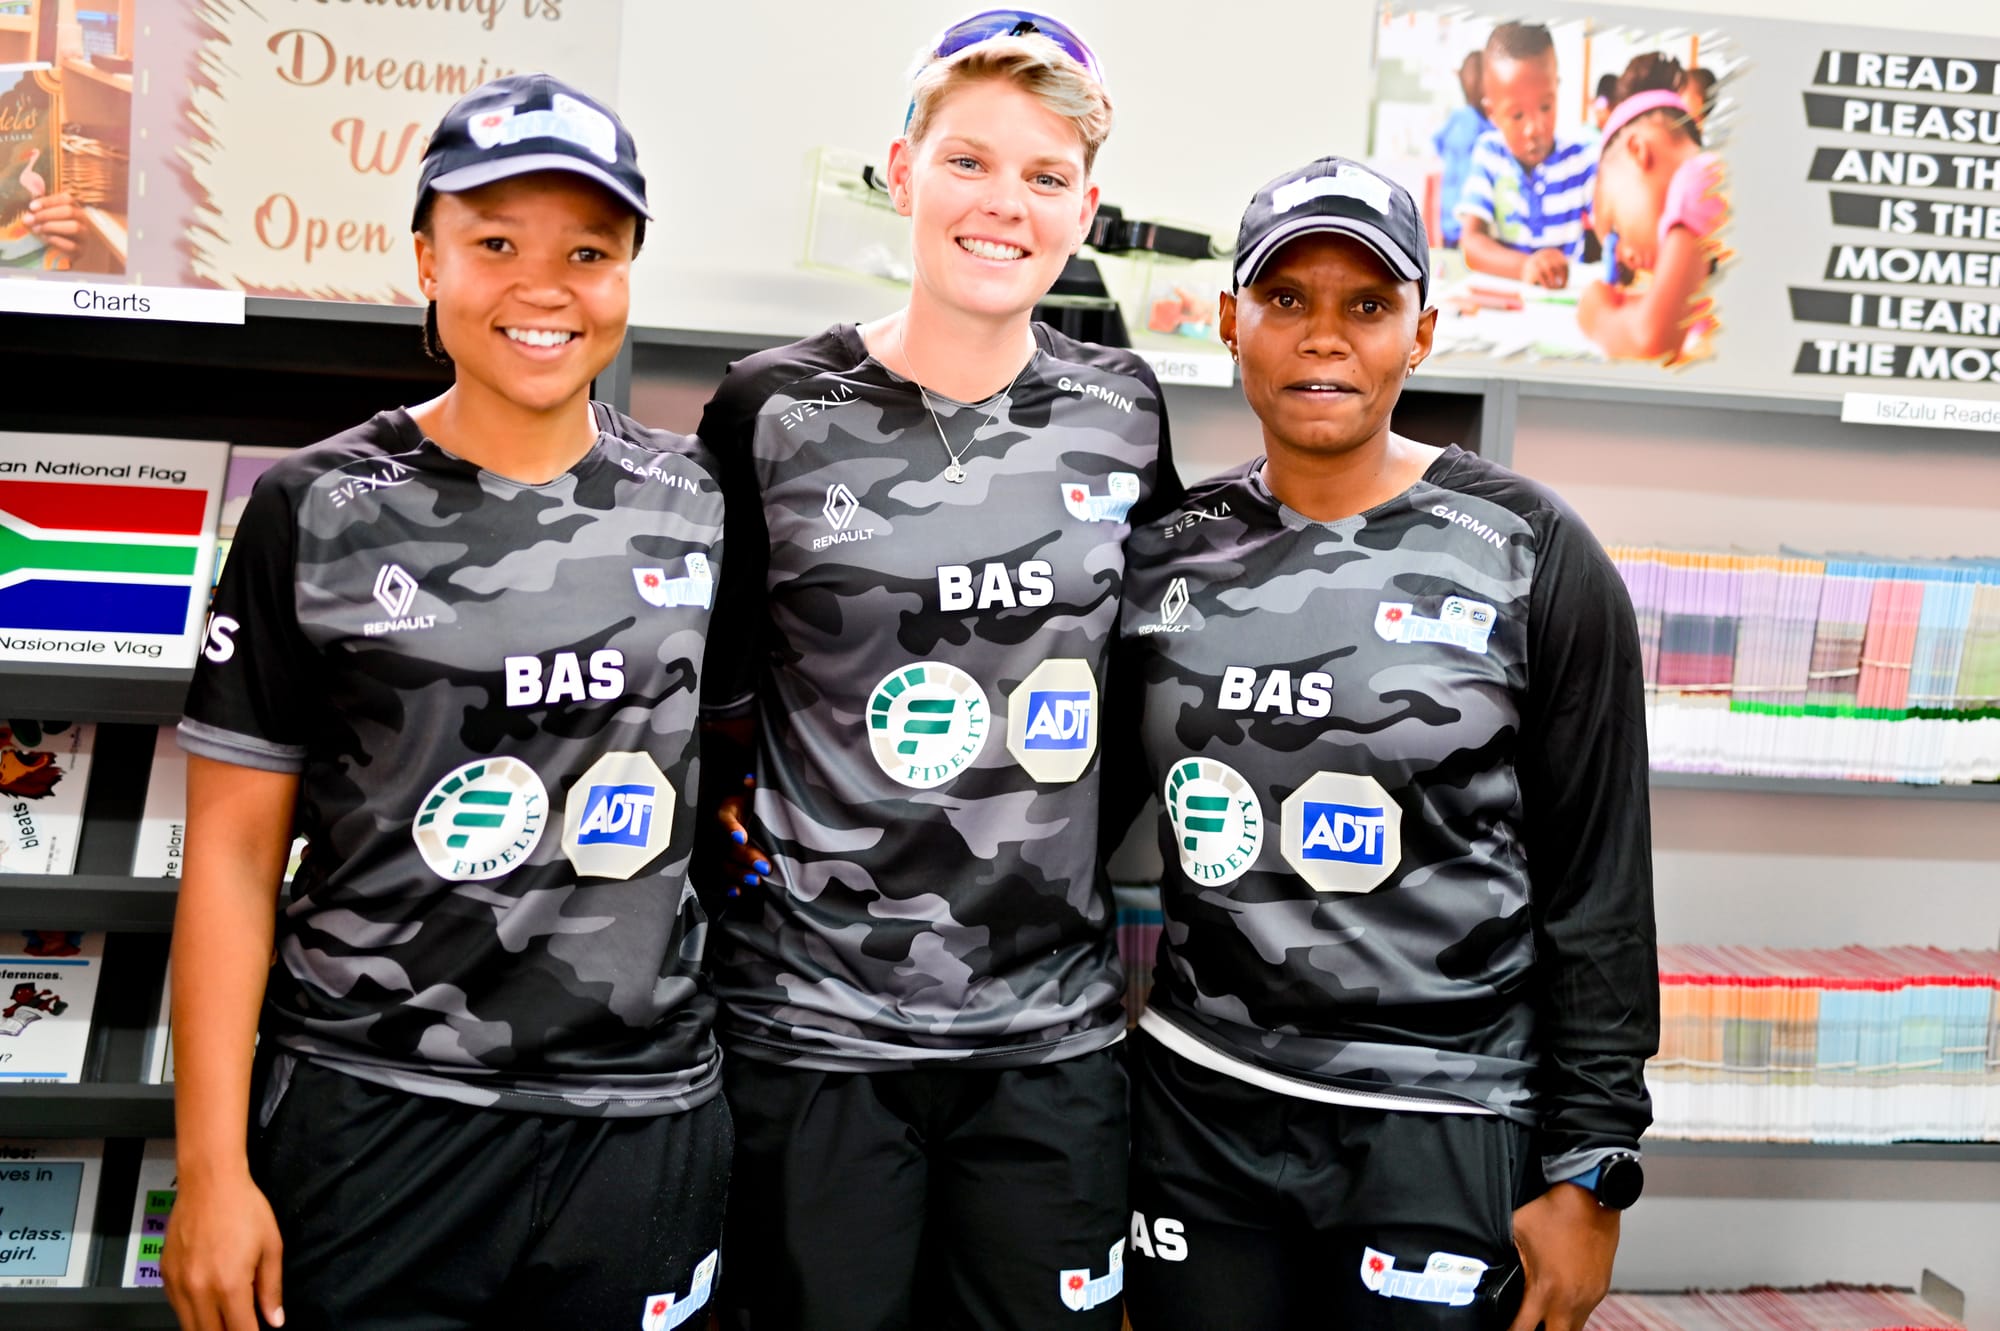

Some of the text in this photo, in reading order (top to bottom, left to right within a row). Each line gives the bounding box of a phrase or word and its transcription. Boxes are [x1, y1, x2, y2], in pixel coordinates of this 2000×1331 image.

[1827, 50, 1842, 84] I
[1856, 53, 1978, 93] READ
[1832, 149, 1939, 187] AND
[255, 193, 393, 263] Open
[1879, 199, 2000, 240] IS THE
[73, 289, 151, 313] Charts
[1851, 293, 1864, 327] I
[1814, 340, 1896, 377] THE
[1057, 377, 1134, 413] GARMIN
[1876, 401, 1936, 420] IsiZulu
[35, 460, 131, 478] National
[138, 465, 186, 484] Flag
[620, 458, 699, 496] GARMIN
[813, 528, 874, 550] RENAULT
[1431, 504, 1507, 550] GARMIN
[937, 560, 1054, 612] BAS
[364, 616, 437, 636] RENAULT
[1138, 624, 1191, 636] RENAULT
[114, 640, 162, 657] Vlag
[504, 649, 625, 707] BAS
[1217, 666, 1334, 718] BAS
[907, 697, 983, 781] FIDELITY
[1025, 700, 1090, 740] ADT
[13, 802, 39, 849] bleats
[579, 793, 654, 836] ADT
[1304, 812, 1384, 855] ADT
[167, 824, 183, 857] plant
[453, 793, 541, 875] FIDELITY
[1194, 799, 1257, 879] FIDELITY
[0, 970, 62, 980] ferences.
[36, 1167, 53, 1181] in
[9, 1227, 65, 1240] class.
[1131, 1210, 1188, 1261] AS
